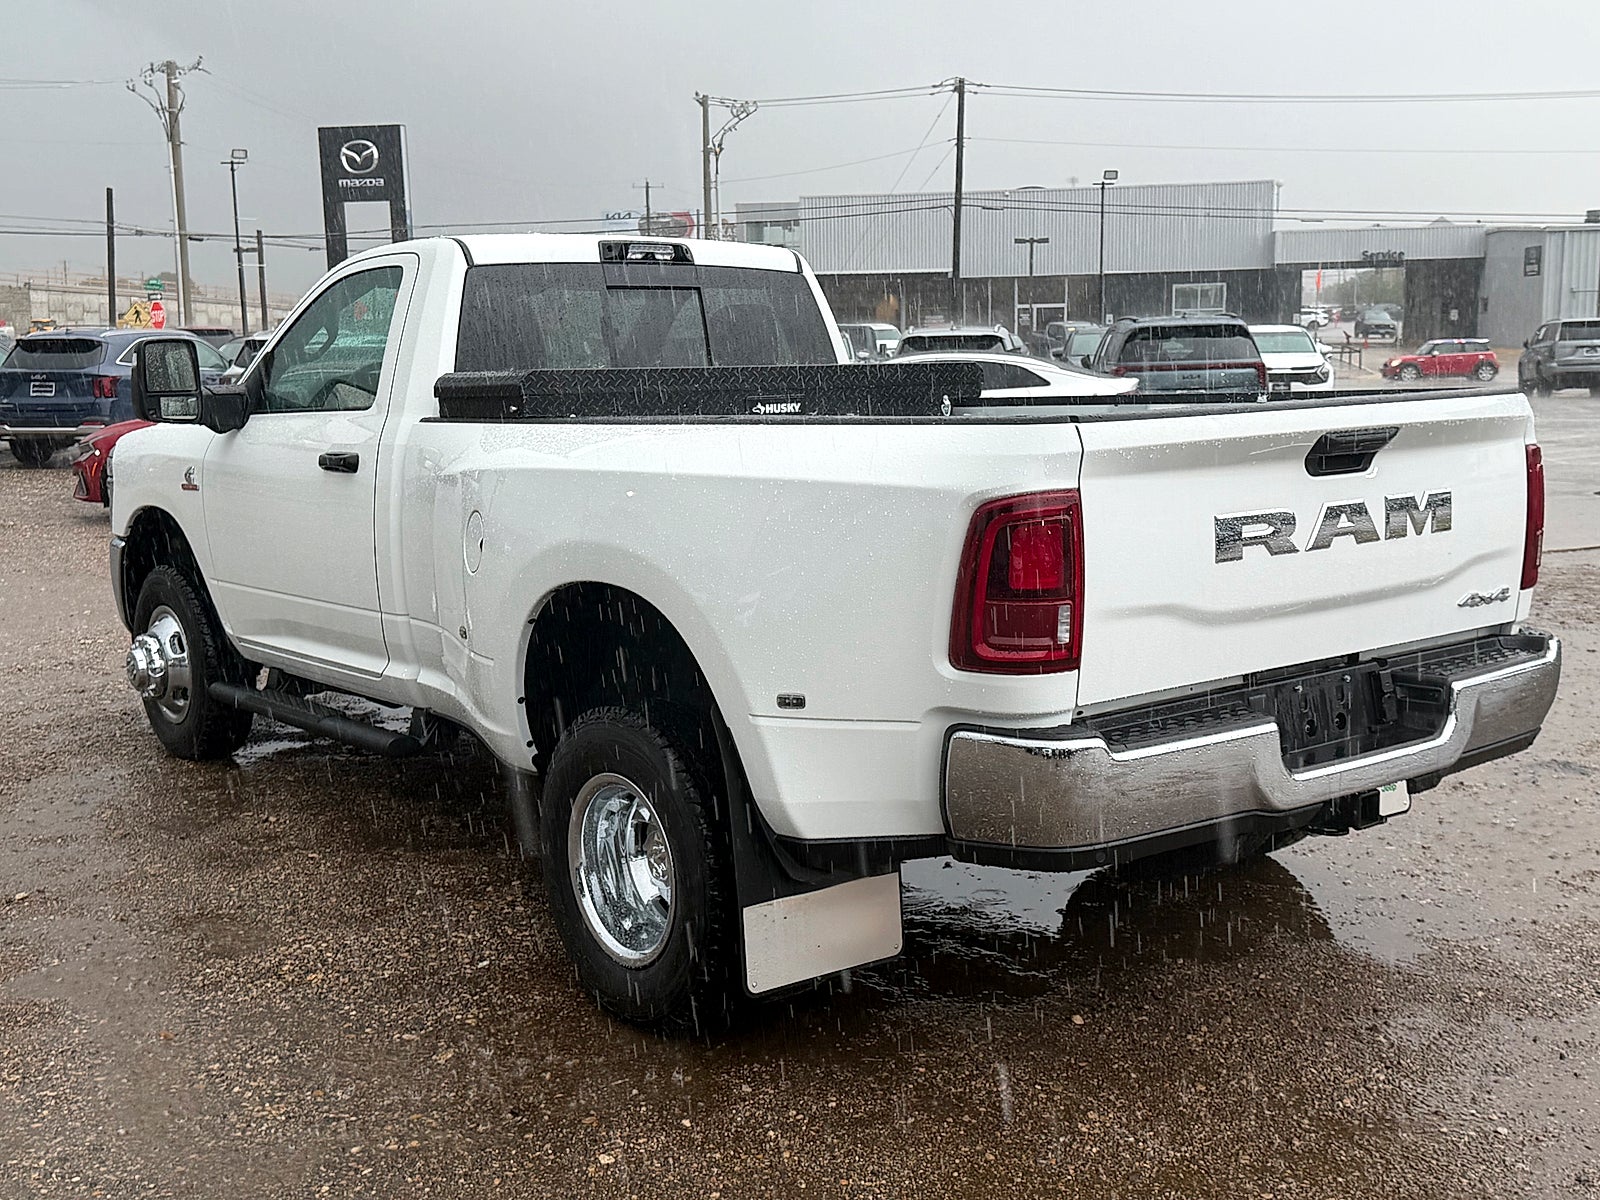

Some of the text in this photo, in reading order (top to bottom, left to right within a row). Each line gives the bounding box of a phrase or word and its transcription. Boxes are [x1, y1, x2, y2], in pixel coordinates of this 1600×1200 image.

[1361, 249, 1405, 261] Service
[151, 310, 164, 323] STOP
[765, 402, 802, 414] HUSKY
[1214, 490, 1452, 564] RAM
[1457, 587, 1511, 608] 4x4
